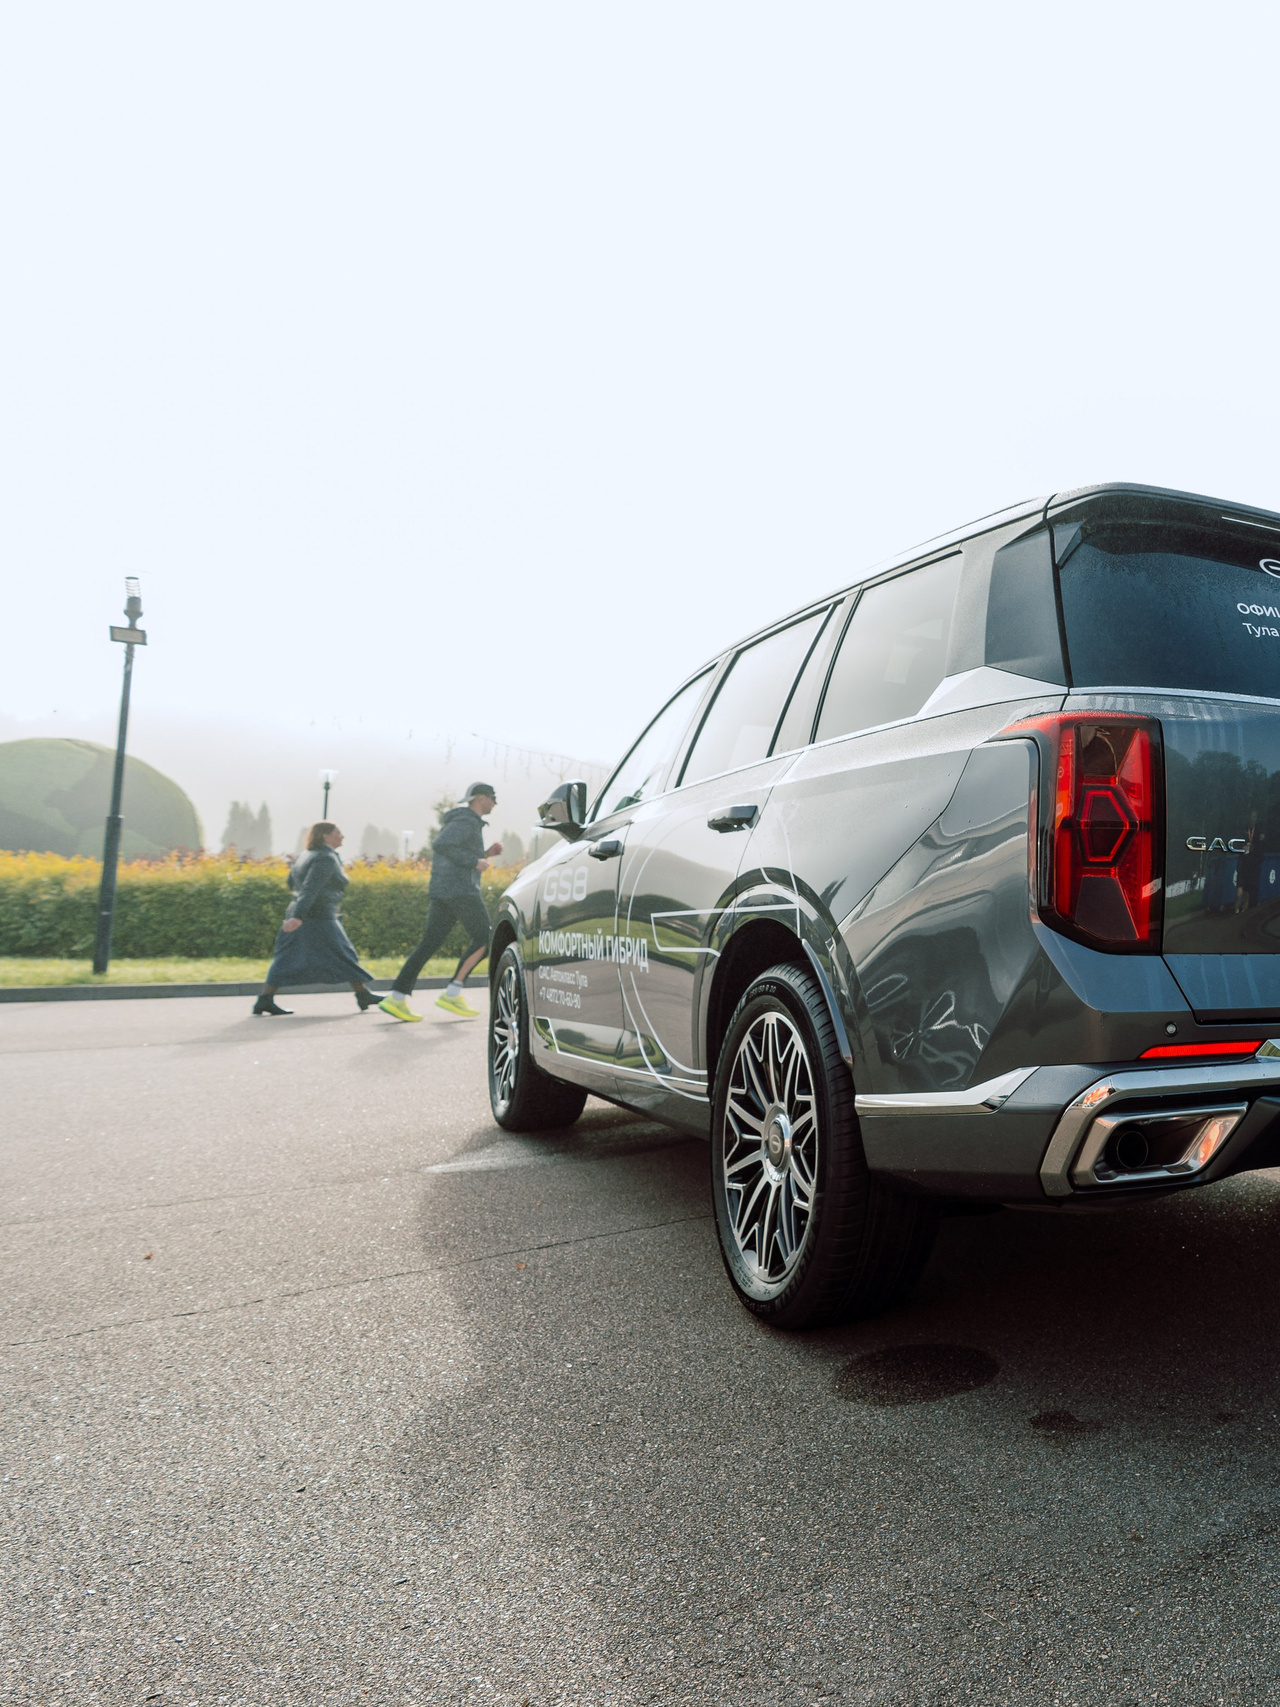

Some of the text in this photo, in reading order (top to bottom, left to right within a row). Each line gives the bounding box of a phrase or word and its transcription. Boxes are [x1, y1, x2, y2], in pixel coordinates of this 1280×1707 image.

[1186, 836, 1246, 853] GAC
[543, 866, 588, 902] GS8
[539, 929, 649, 974] КОМФОРТНЫЙ ГИБРИД
